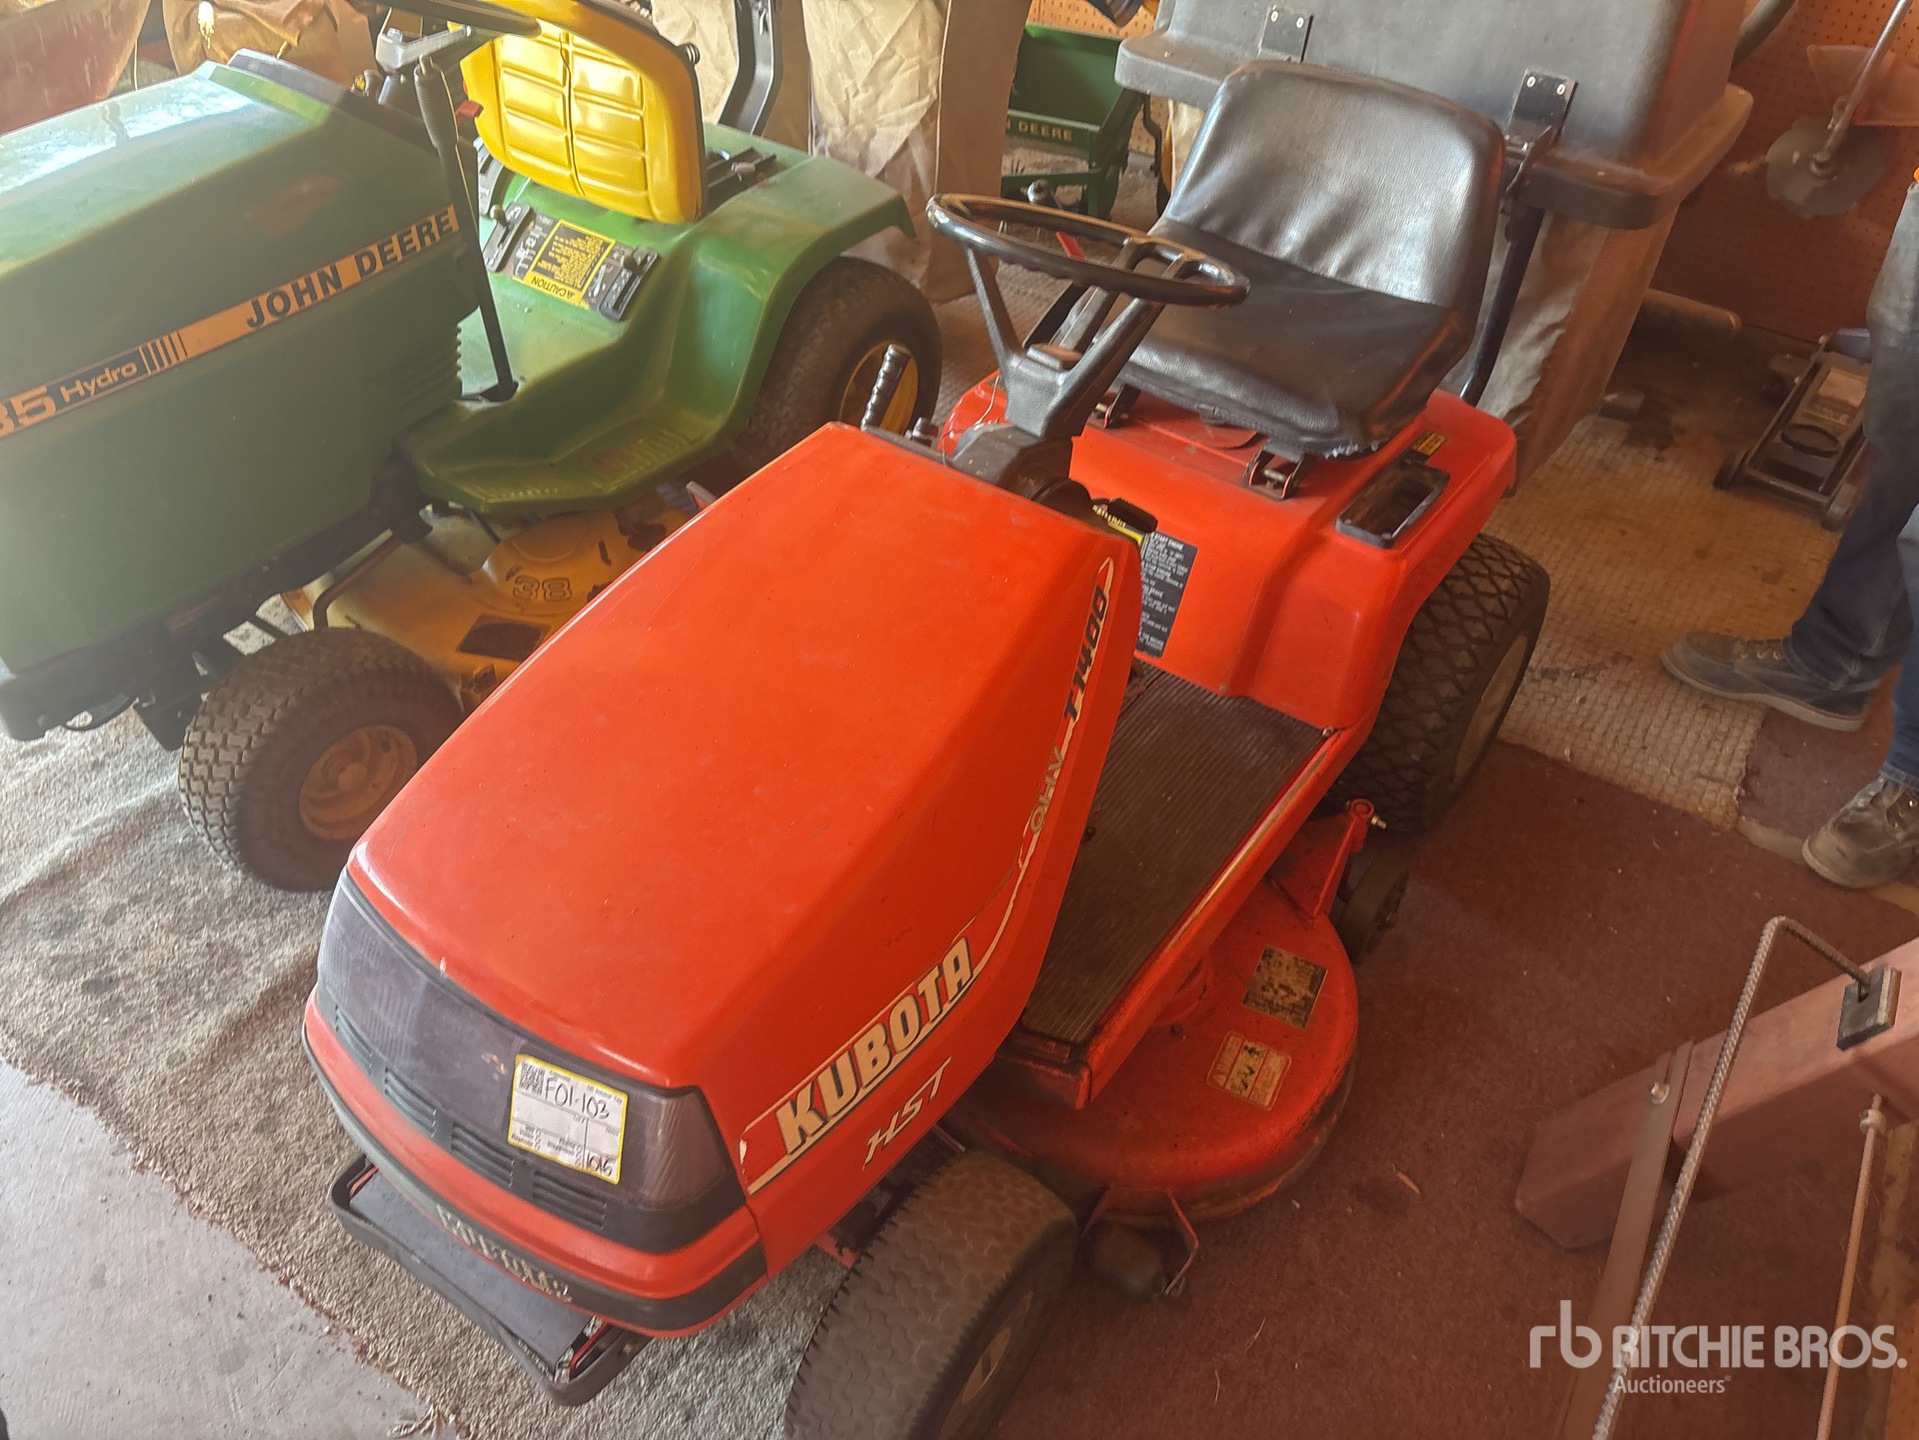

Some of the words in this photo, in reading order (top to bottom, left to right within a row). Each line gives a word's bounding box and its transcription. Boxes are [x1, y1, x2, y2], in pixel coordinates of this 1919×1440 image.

[1018, 119, 1073, 143] DEERE
[60, 362, 138, 403] Hydro
[246, 264, 344, 329] JOHN
[354, 208, 457, 281] DEERE
[531, 276, 567, 297] CAUTION
[512, 575, 573, 603] 38
[1030, 746, 1064, 835] OHV
[775, 936, 974, 1156] KUBOTA
[862, 1056, 952, 1171] HST
